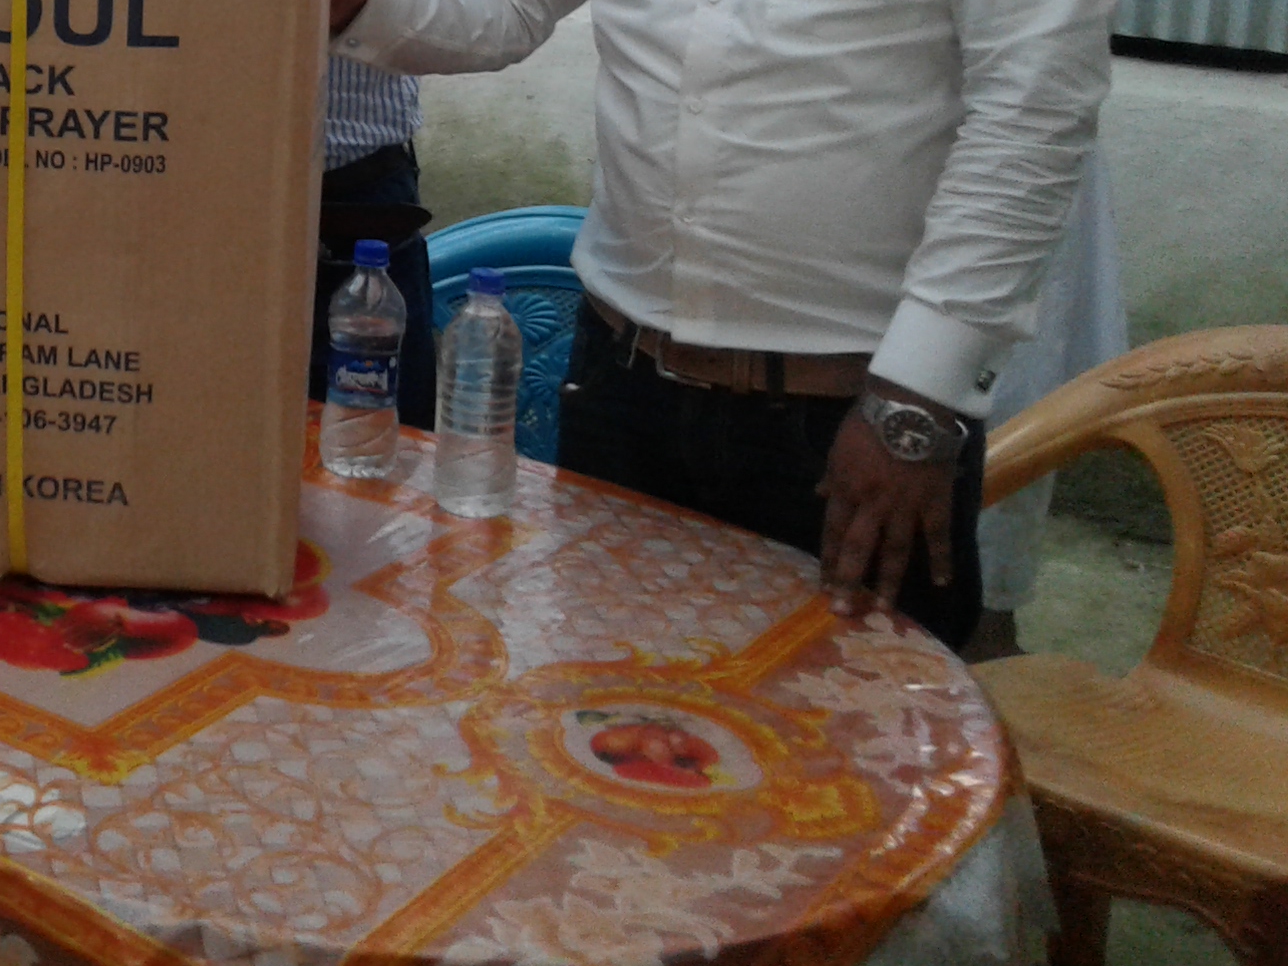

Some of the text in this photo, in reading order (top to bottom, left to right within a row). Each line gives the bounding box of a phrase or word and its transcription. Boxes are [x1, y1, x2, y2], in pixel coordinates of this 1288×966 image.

[36, 150, 66, 170] NO
[84, 152, 167, 174] HP-0903
[67, 349, 141, 372] LANE
